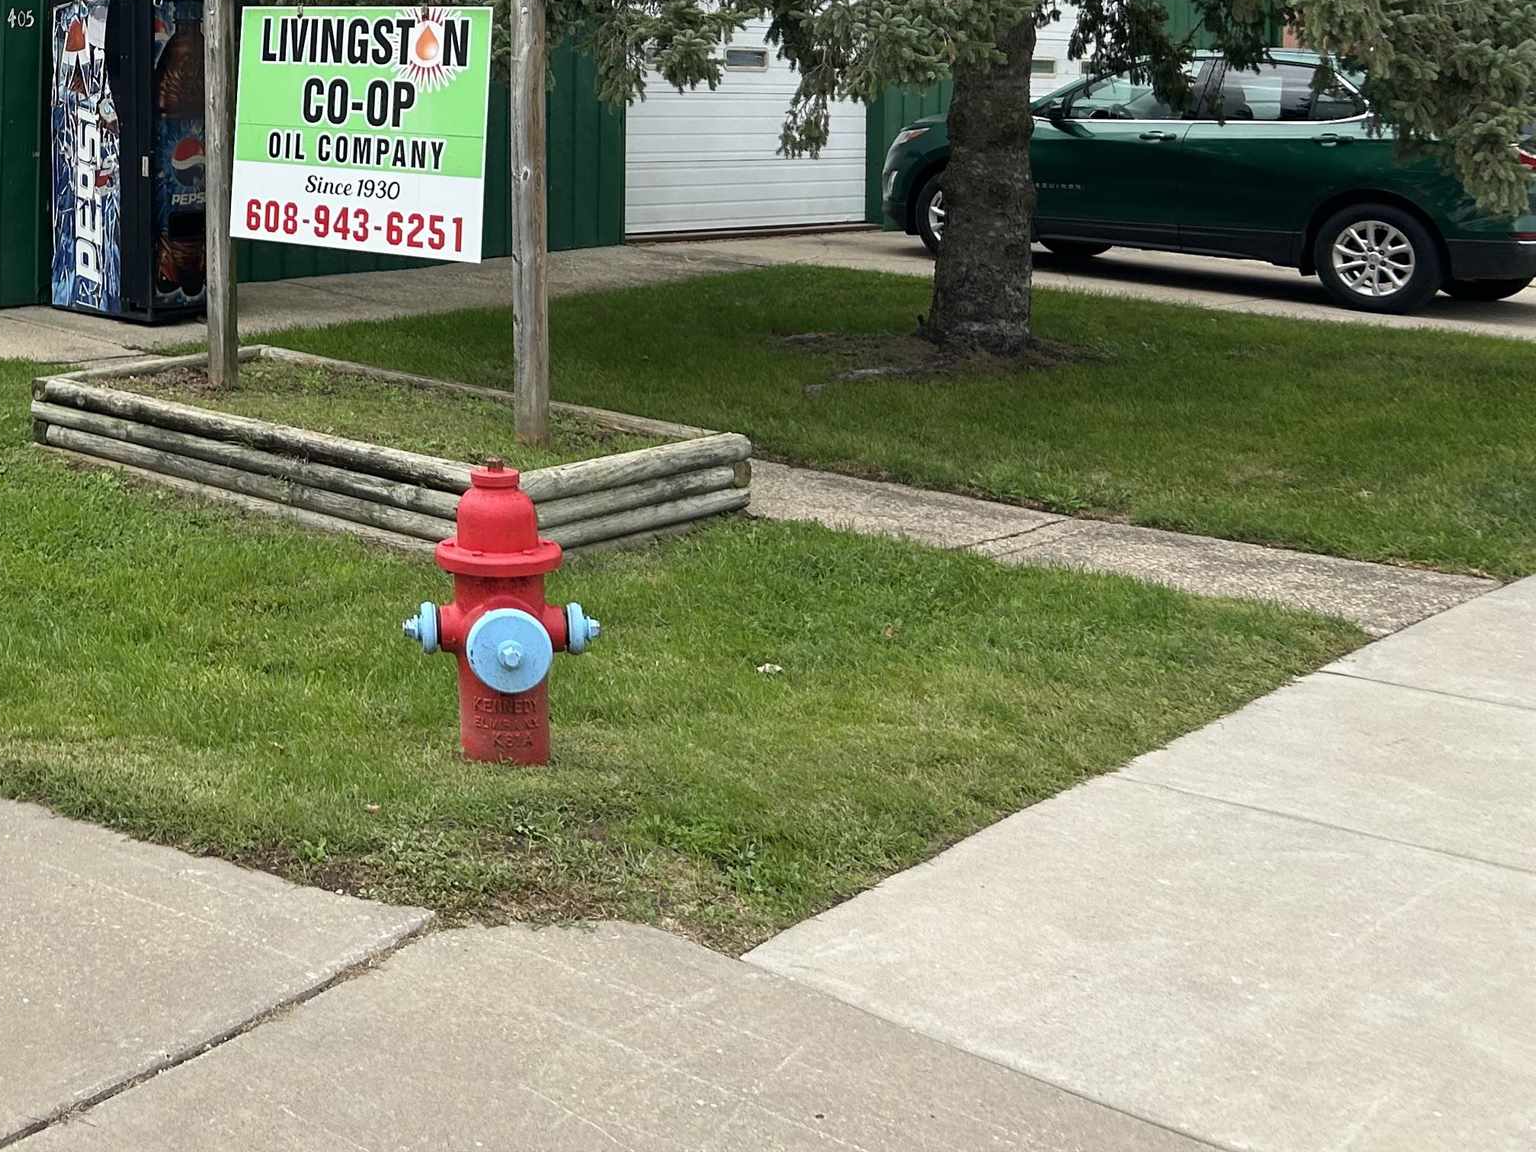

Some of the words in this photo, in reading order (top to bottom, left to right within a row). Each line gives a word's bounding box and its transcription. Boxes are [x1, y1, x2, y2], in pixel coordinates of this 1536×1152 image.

[7, 7, 35, 28] 405
[302, 77, 416, 128] CO-OP
[268, 131, 305, 160] OIL
[317, 134, 445, 170] COMPANY
[76, 106, 102, 297] PEPSI
[171, 192, 206, 206] PEPS
[304, 175, 352, 196] Since
[356, 179, 401, 200] 1930
[245, 199, 464, 252] 608-943-6251
